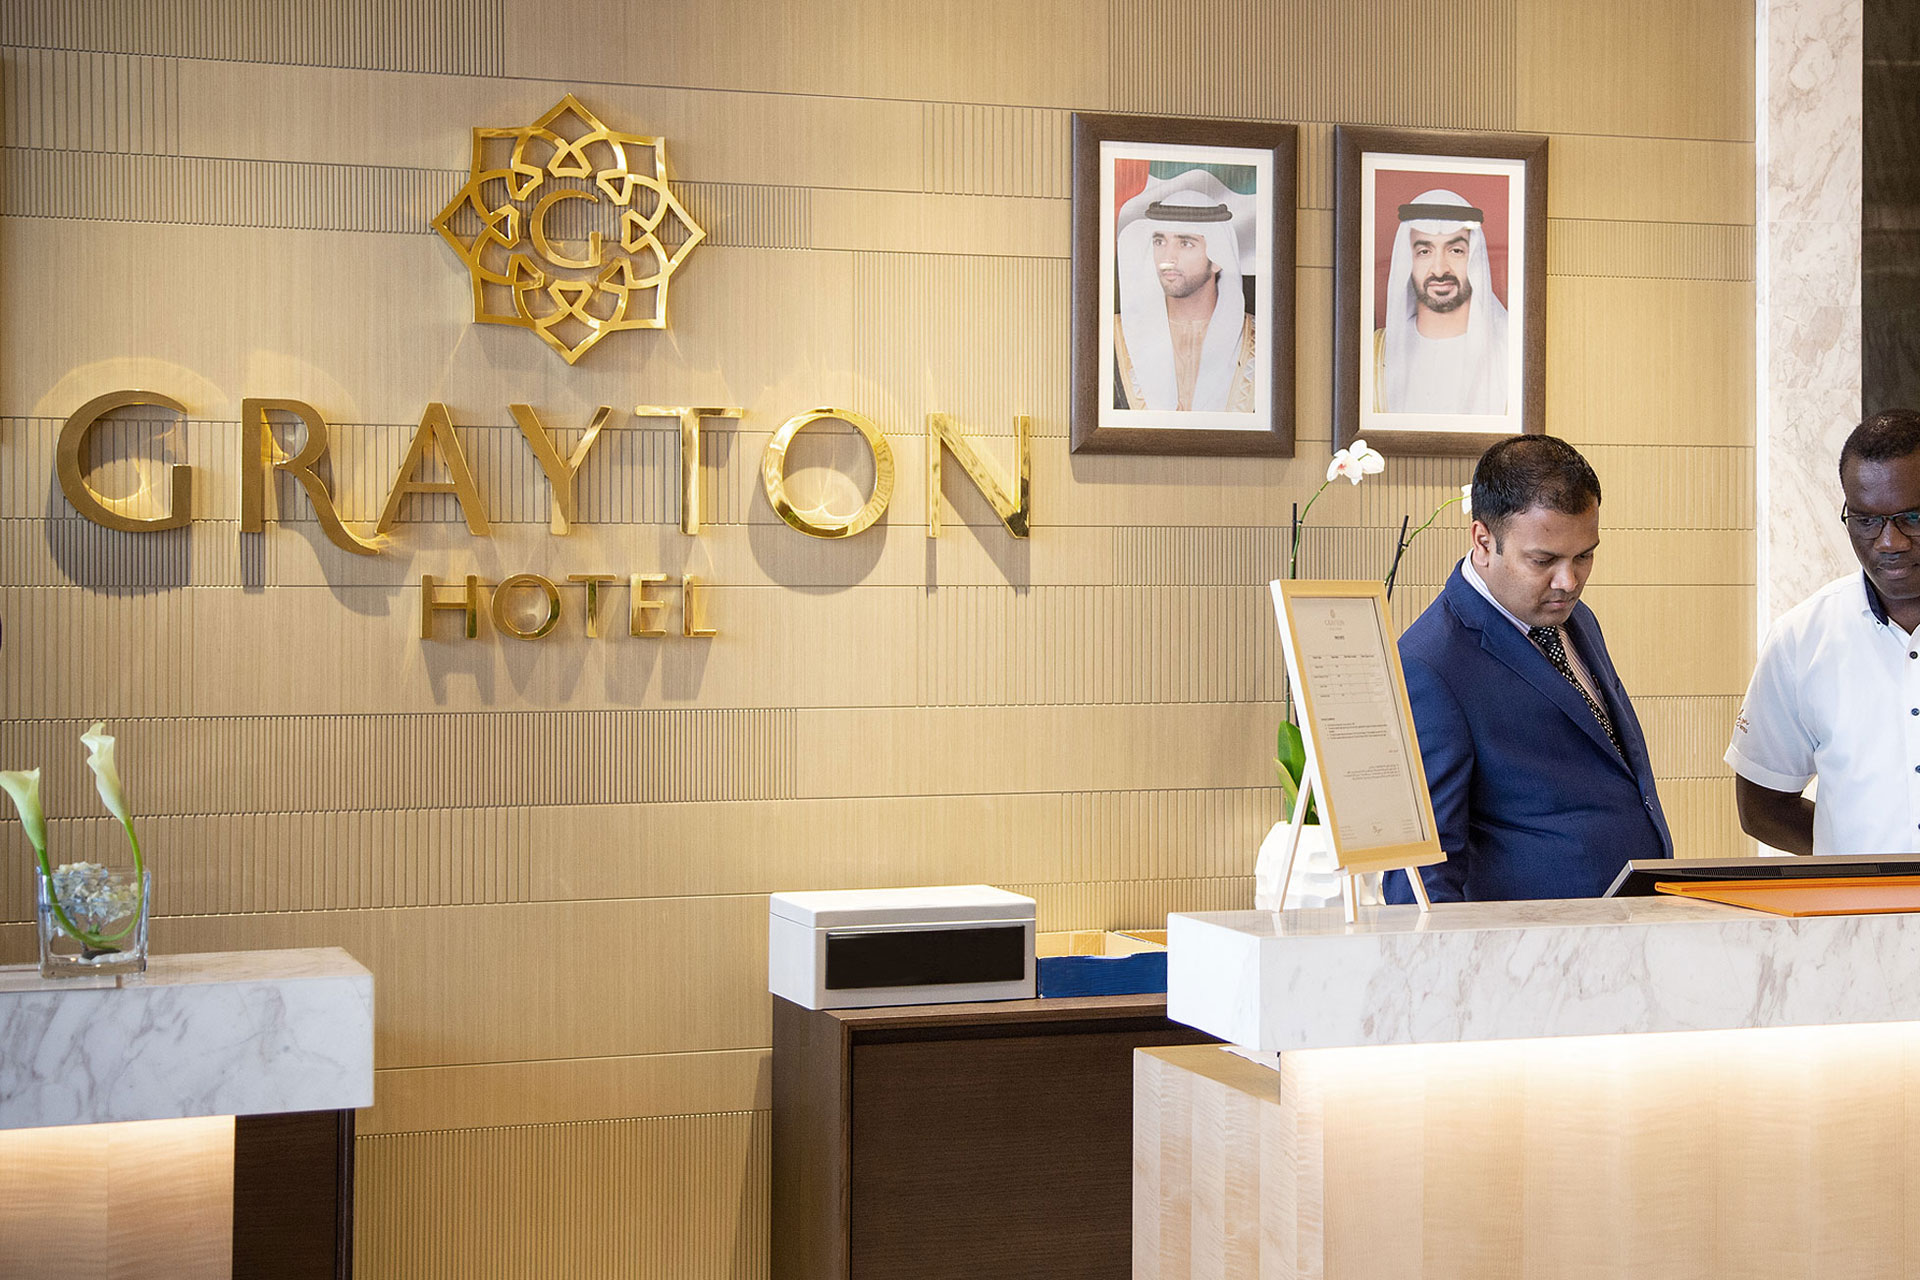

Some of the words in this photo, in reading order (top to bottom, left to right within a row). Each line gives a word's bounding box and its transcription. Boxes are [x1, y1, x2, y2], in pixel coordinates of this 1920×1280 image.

[530, 189, 601, 268] G
[56, 388, 1030, 555] GRAYTON
[420, 573, 717, 640] HOTEL
